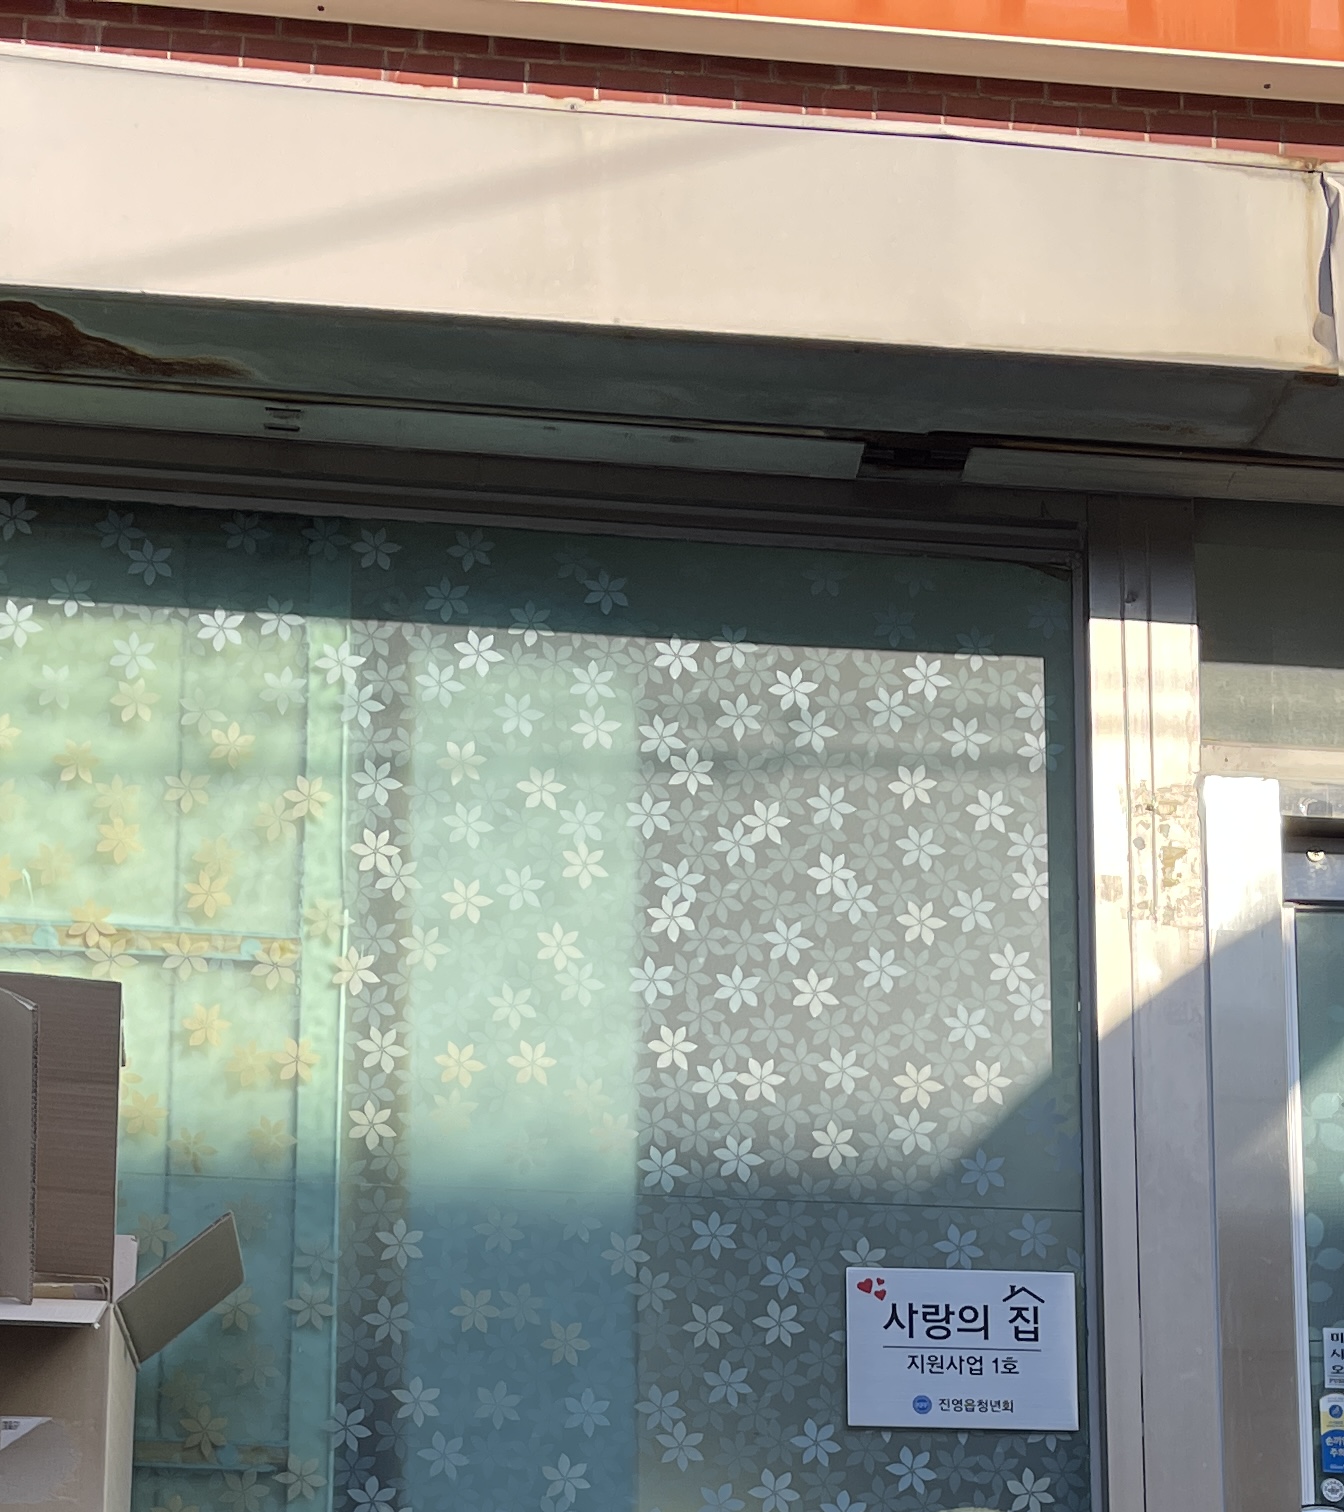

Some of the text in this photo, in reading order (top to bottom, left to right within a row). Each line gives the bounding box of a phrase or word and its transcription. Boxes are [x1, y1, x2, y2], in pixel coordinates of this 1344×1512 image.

[882, 1302, 1040, 1342] 사랑의 집
[907, 1354, 1020, 1376] 지원사업 1호
[938, 1398, 1015, 1413] 진영읍청년회
